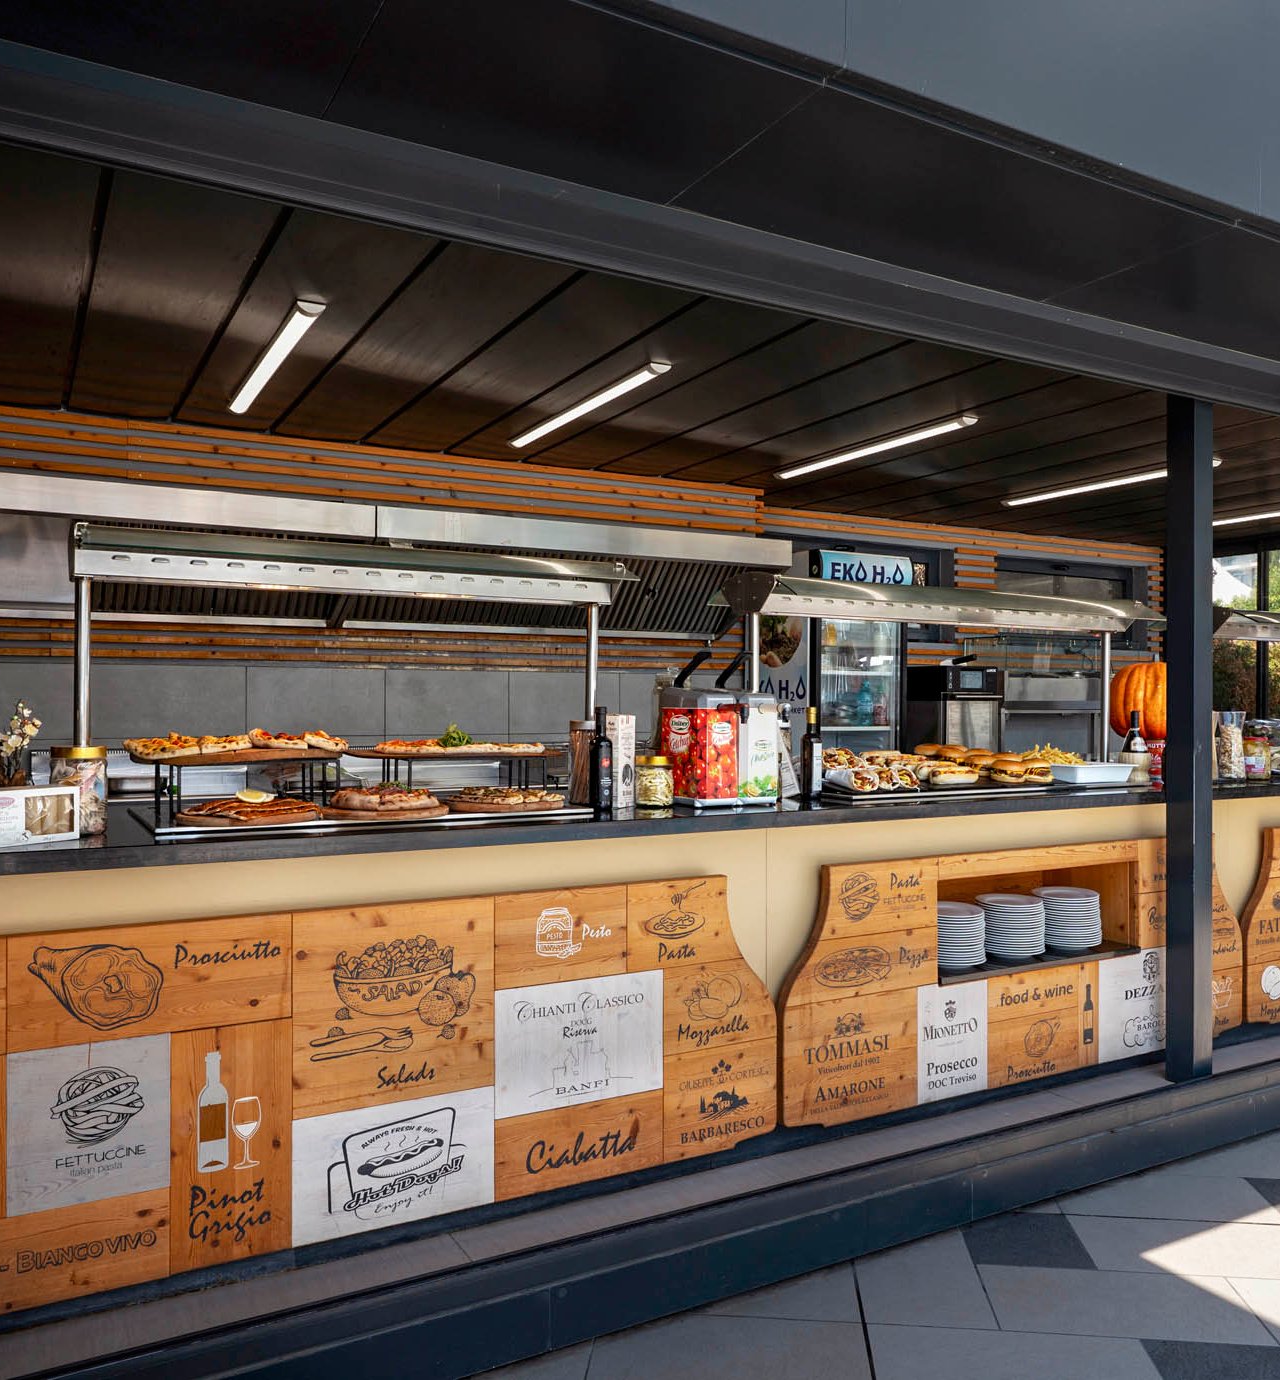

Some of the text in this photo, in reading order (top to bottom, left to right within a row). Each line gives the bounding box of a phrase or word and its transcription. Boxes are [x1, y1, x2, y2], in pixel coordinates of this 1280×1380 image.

[890, 872, 921, 890] Pasta
[582, 923, 612, 941] Pesto
[174, 939, 282, 969] Prosciutto
[658, 942, 696, 962] Pasta
[362, 980, 423, 1002] SALAD
[1000, 984, 1074, 1007] food & wine
[513, 992, 644, 1023] CHIANTI CLASSICO
[563, 1026, 598, 1039] Riserva
[677, 1014, 750, 1047] Mozzarella
[922, 1017, 978, 1041] MIONETTO
[803, 1034, 890, 1065] TOMMASI
[377, 1061, 436, 1088] Salads
[927, 1056, 978, 1077] Prosecco
[1007, 1060, 1056, 1080] Prosciutto
[555, 1079, 610, 1095] BANFI
[815, 1076, 886, 1103] AMARONE
[928, 1073, 977, 1090] DOC Treviso
[361, 1130, 390, 1149] ALWAYS
[391, 1125, 415, 1134] FRESH
[422, 1126, 438, 1134] HOT
[681, 1115, 765, 1144] BARBARESCO
[55, 1144, 147, 1169] FETTUCCINE
[526, 1130, 637, 1174] Ciabatta
[189, 1177, 265, 1217] Pinot
[374, 1197, 412, 1213] Enjoy
[189, 1205, 272, 1243] Grigio
[16, 1240, 103, 1275] BIANCO
[106, 1229, 158, 1255] VIVO
